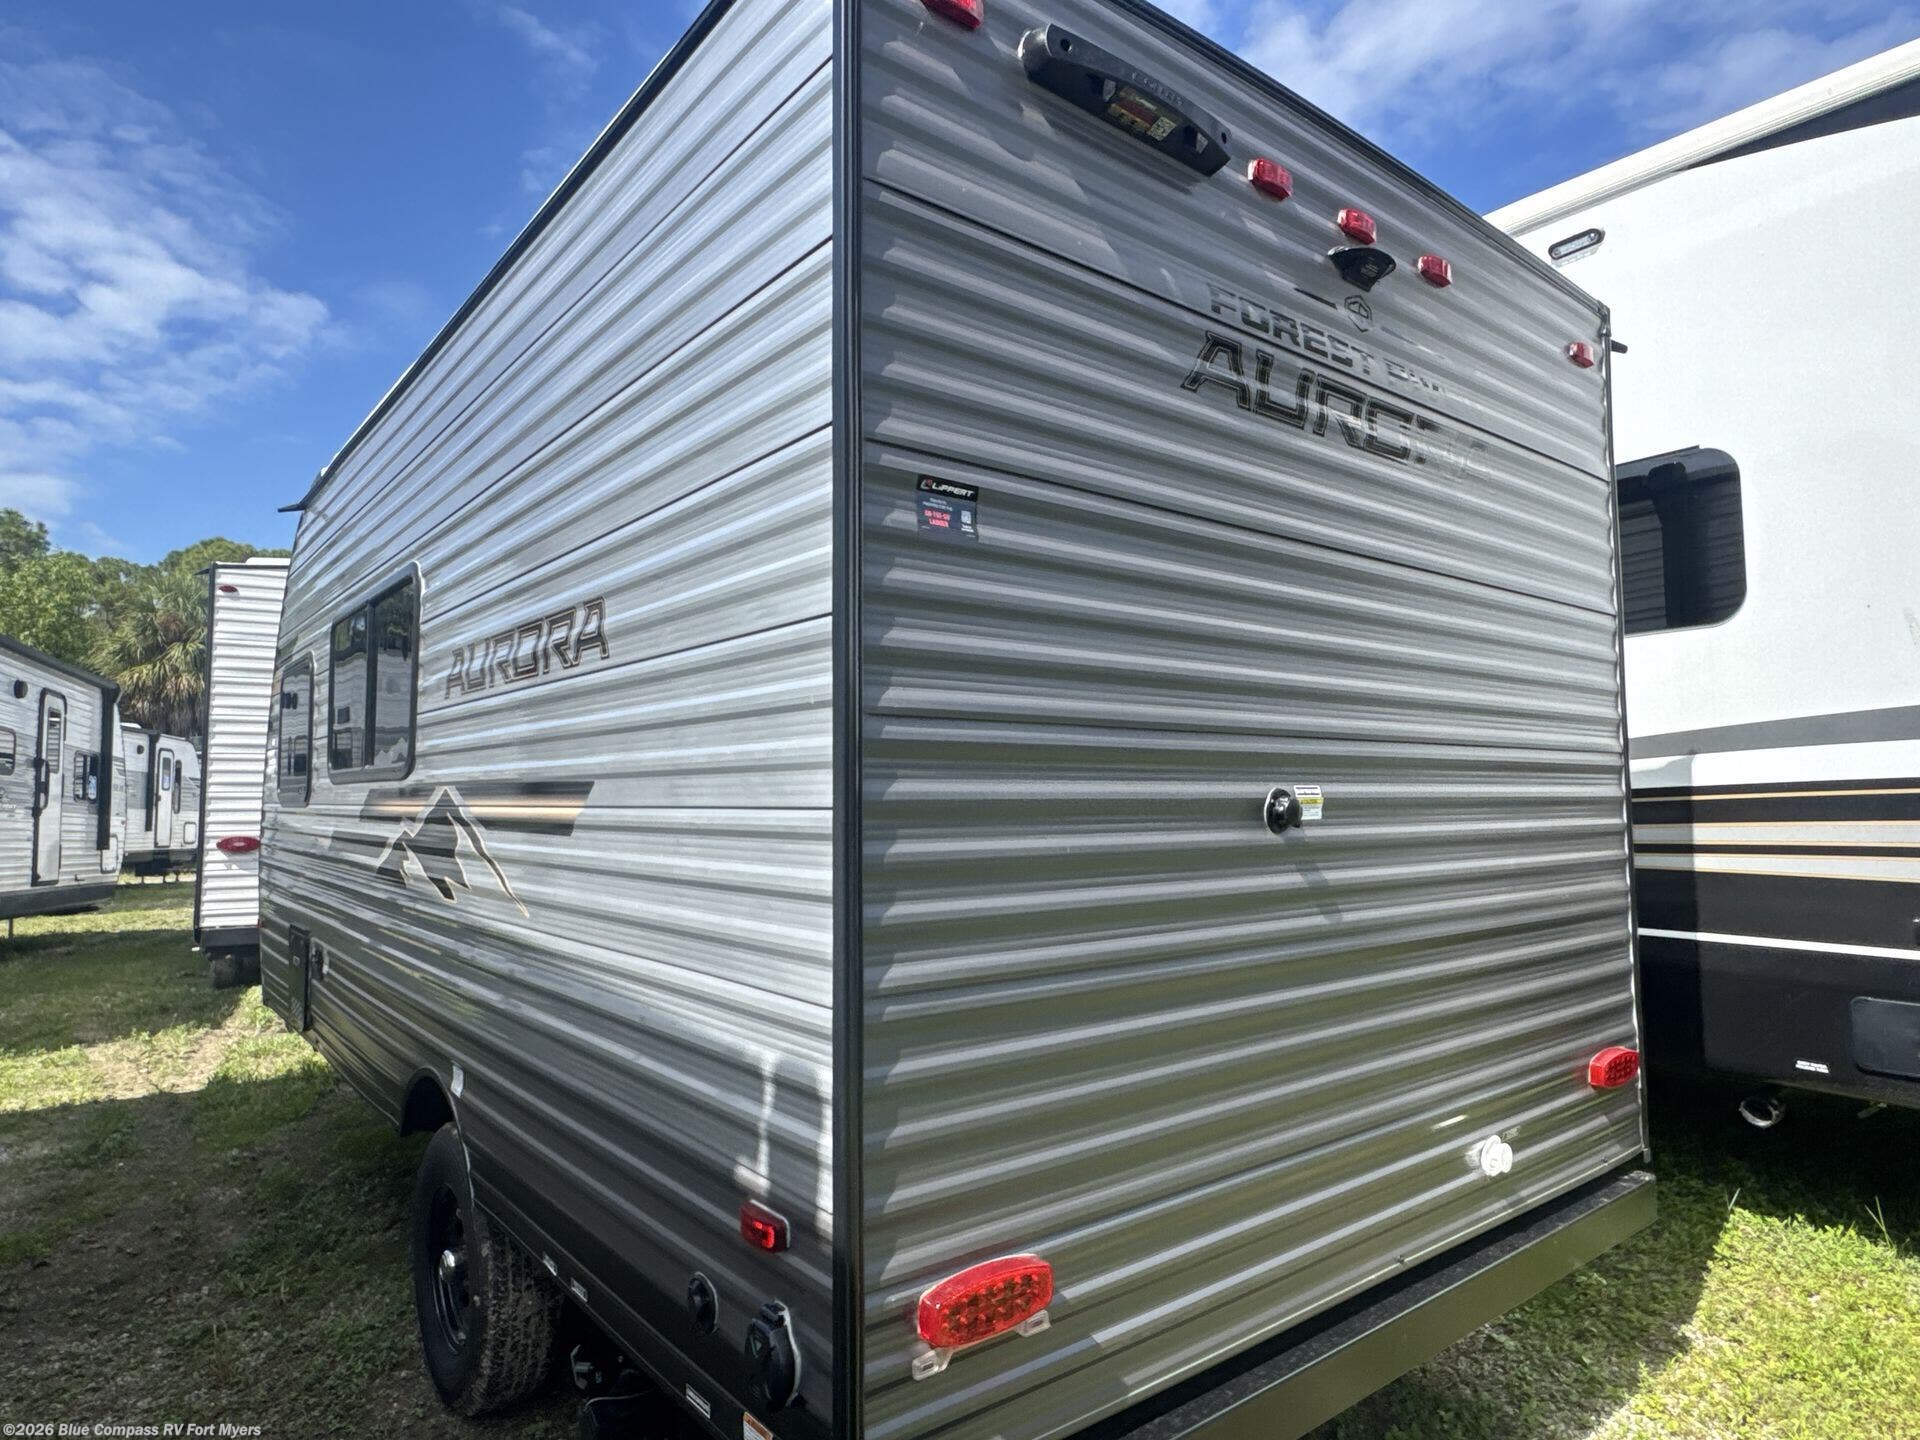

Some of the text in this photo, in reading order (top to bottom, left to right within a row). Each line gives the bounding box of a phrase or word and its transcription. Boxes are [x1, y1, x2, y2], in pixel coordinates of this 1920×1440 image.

[1207, 281, 1375, 377] FOREST
[1180, 329, 1492, 484] AURO
[444, 595, 610, 700] AURORA
